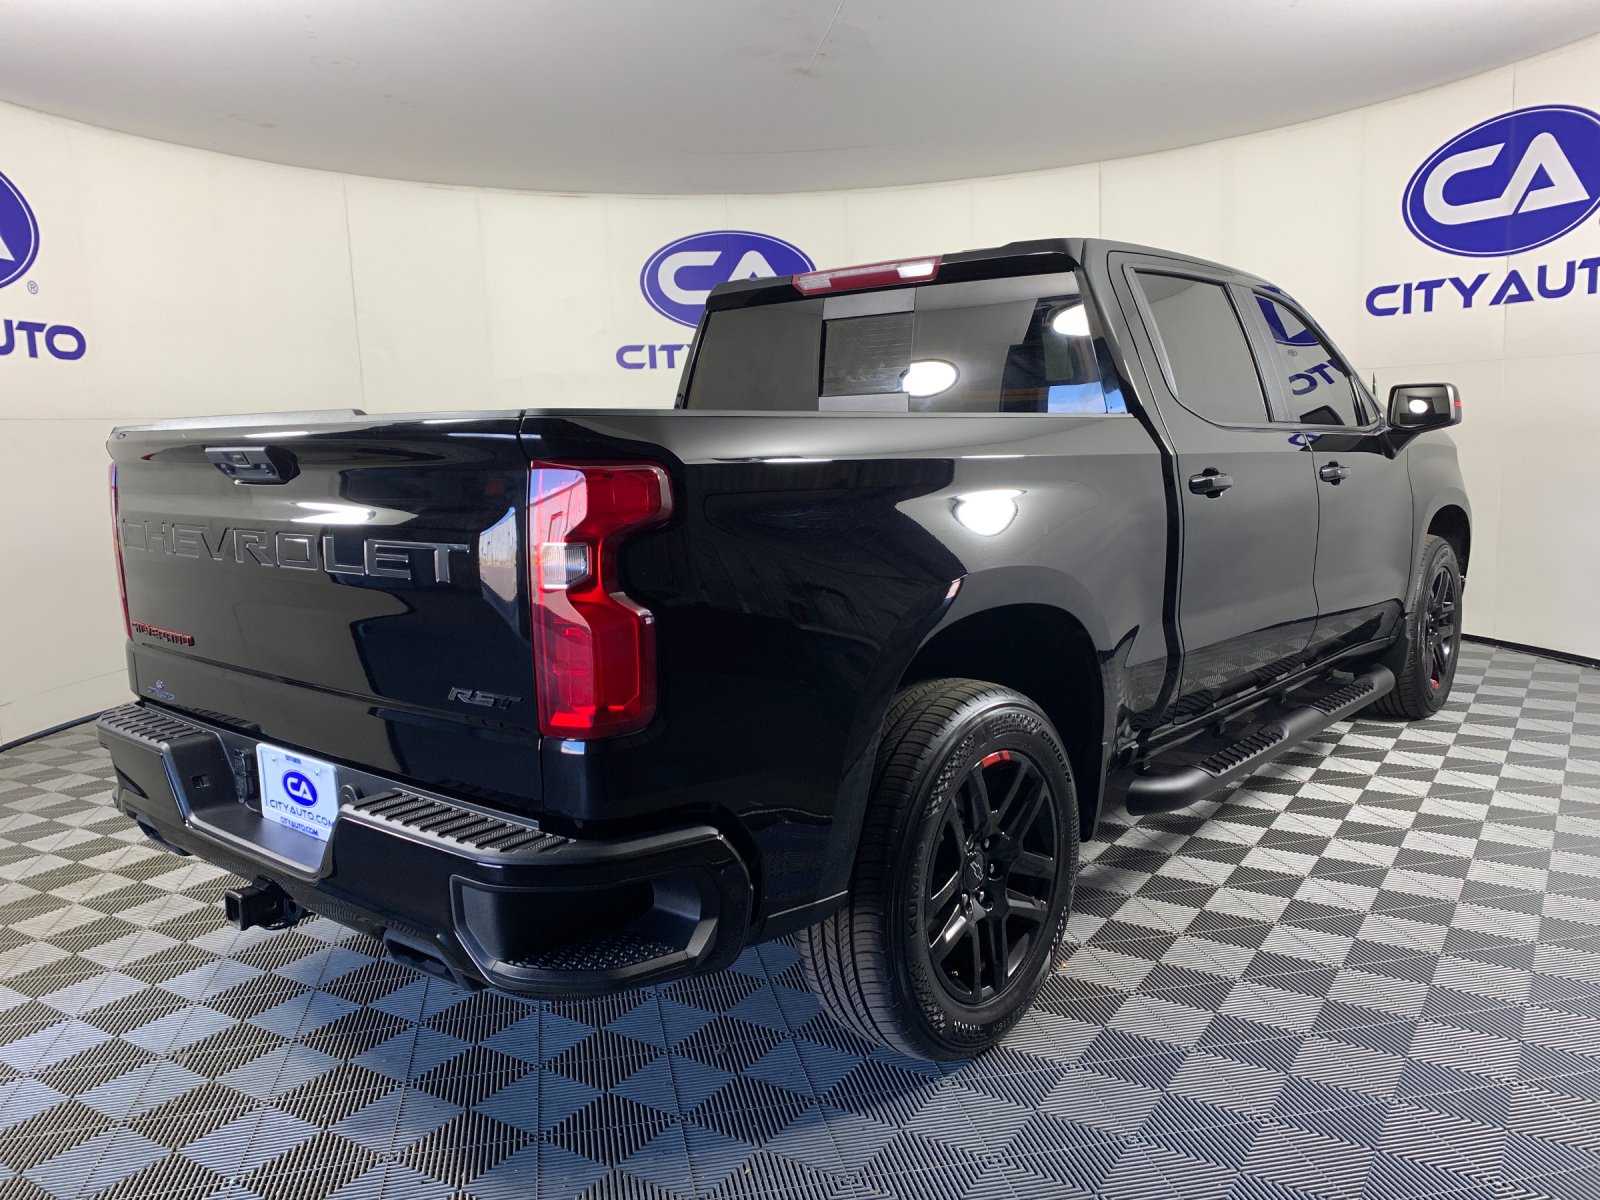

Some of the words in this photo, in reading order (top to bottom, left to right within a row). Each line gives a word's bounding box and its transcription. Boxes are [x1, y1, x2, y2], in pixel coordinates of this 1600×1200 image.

[1423, 132, 1591, 226] CA
[615, 344, 691, 370] CIT
[122, 519, 470, 583] CHEVROLET
[447, 687, 524, 710] RST
[1040, 731, 1073, 784] CRUGEN
[286, 776, 314, 802] CA
